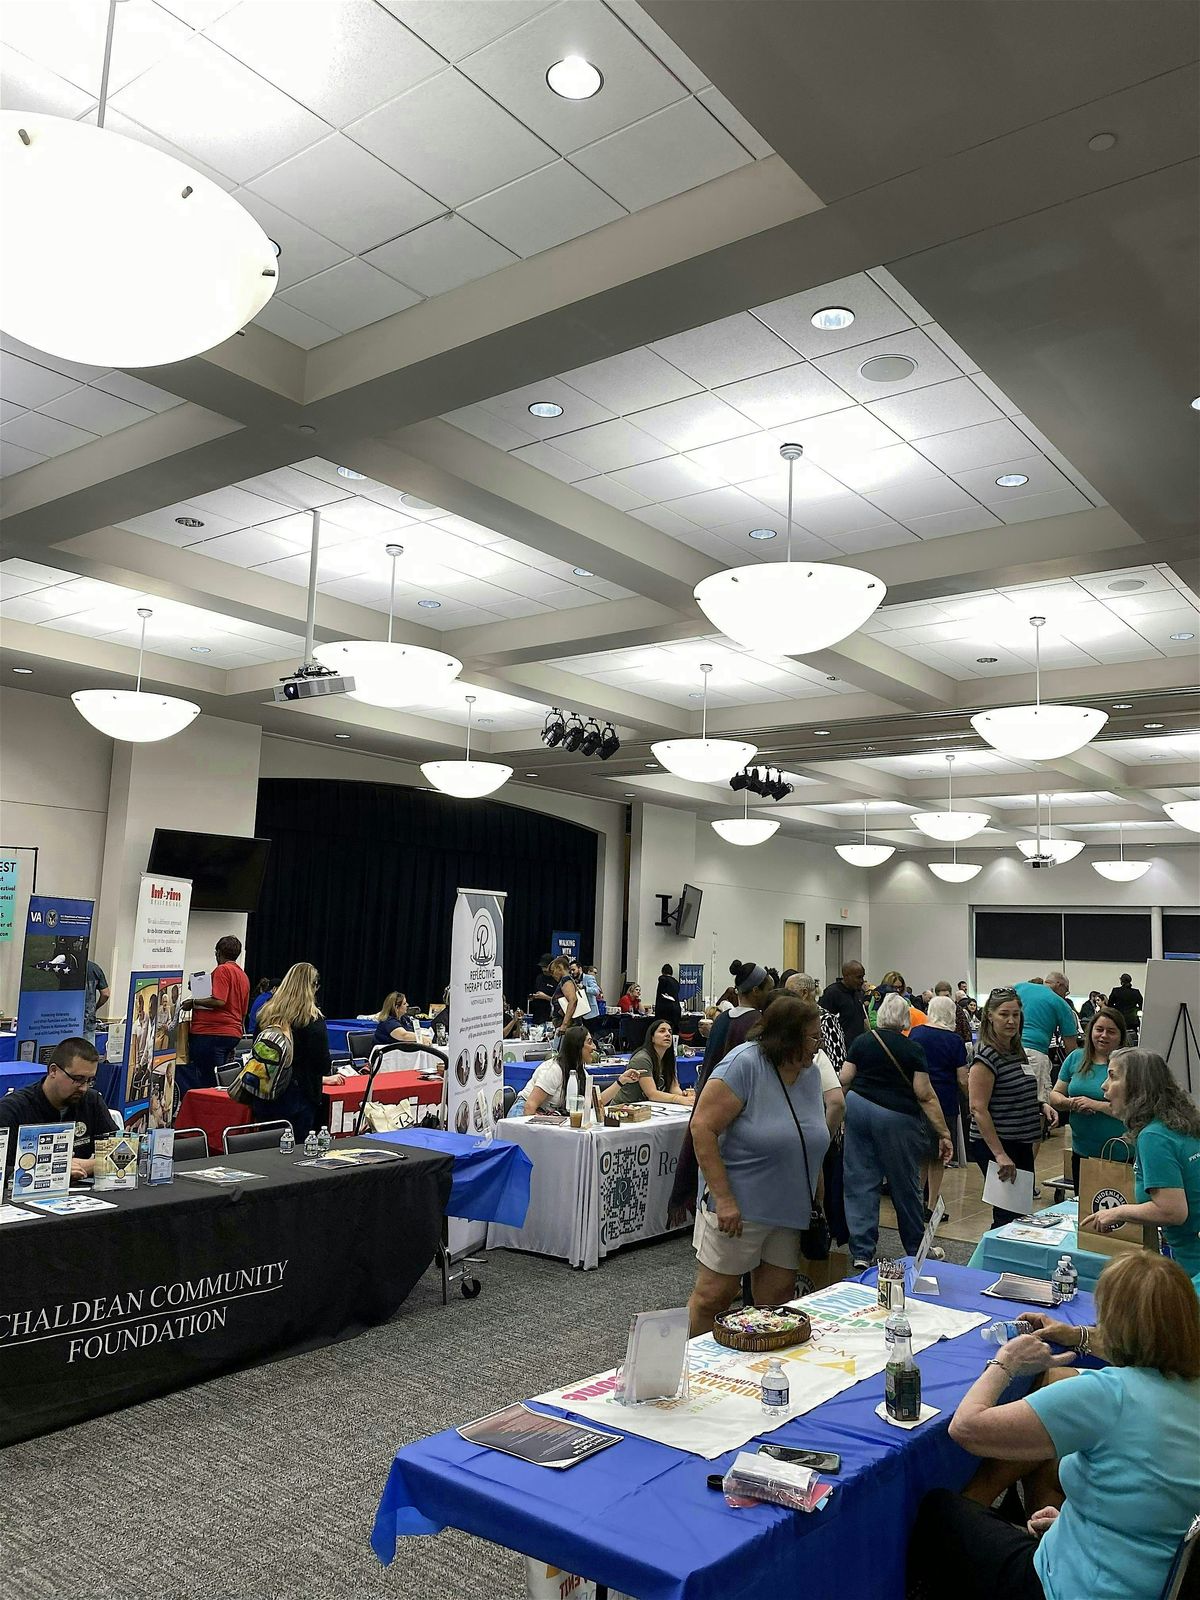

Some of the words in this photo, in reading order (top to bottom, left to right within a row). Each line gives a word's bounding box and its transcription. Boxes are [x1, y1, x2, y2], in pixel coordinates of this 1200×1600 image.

[31, 911, 42, 923] VA
[470, 968, 495, 981] REFLECTIVE
[464, 982, 483, 993] THERAPY
[484, 979, 502, 991] CENTER
[1094, 1190, 1125, 1205] UNDENIABL
[0, 1289, 145, 1340] CHALDEAN
[150, 1259, 289, 1309] COMMUNITY
[66, 1306, 228, 1364] FOUNDATION
